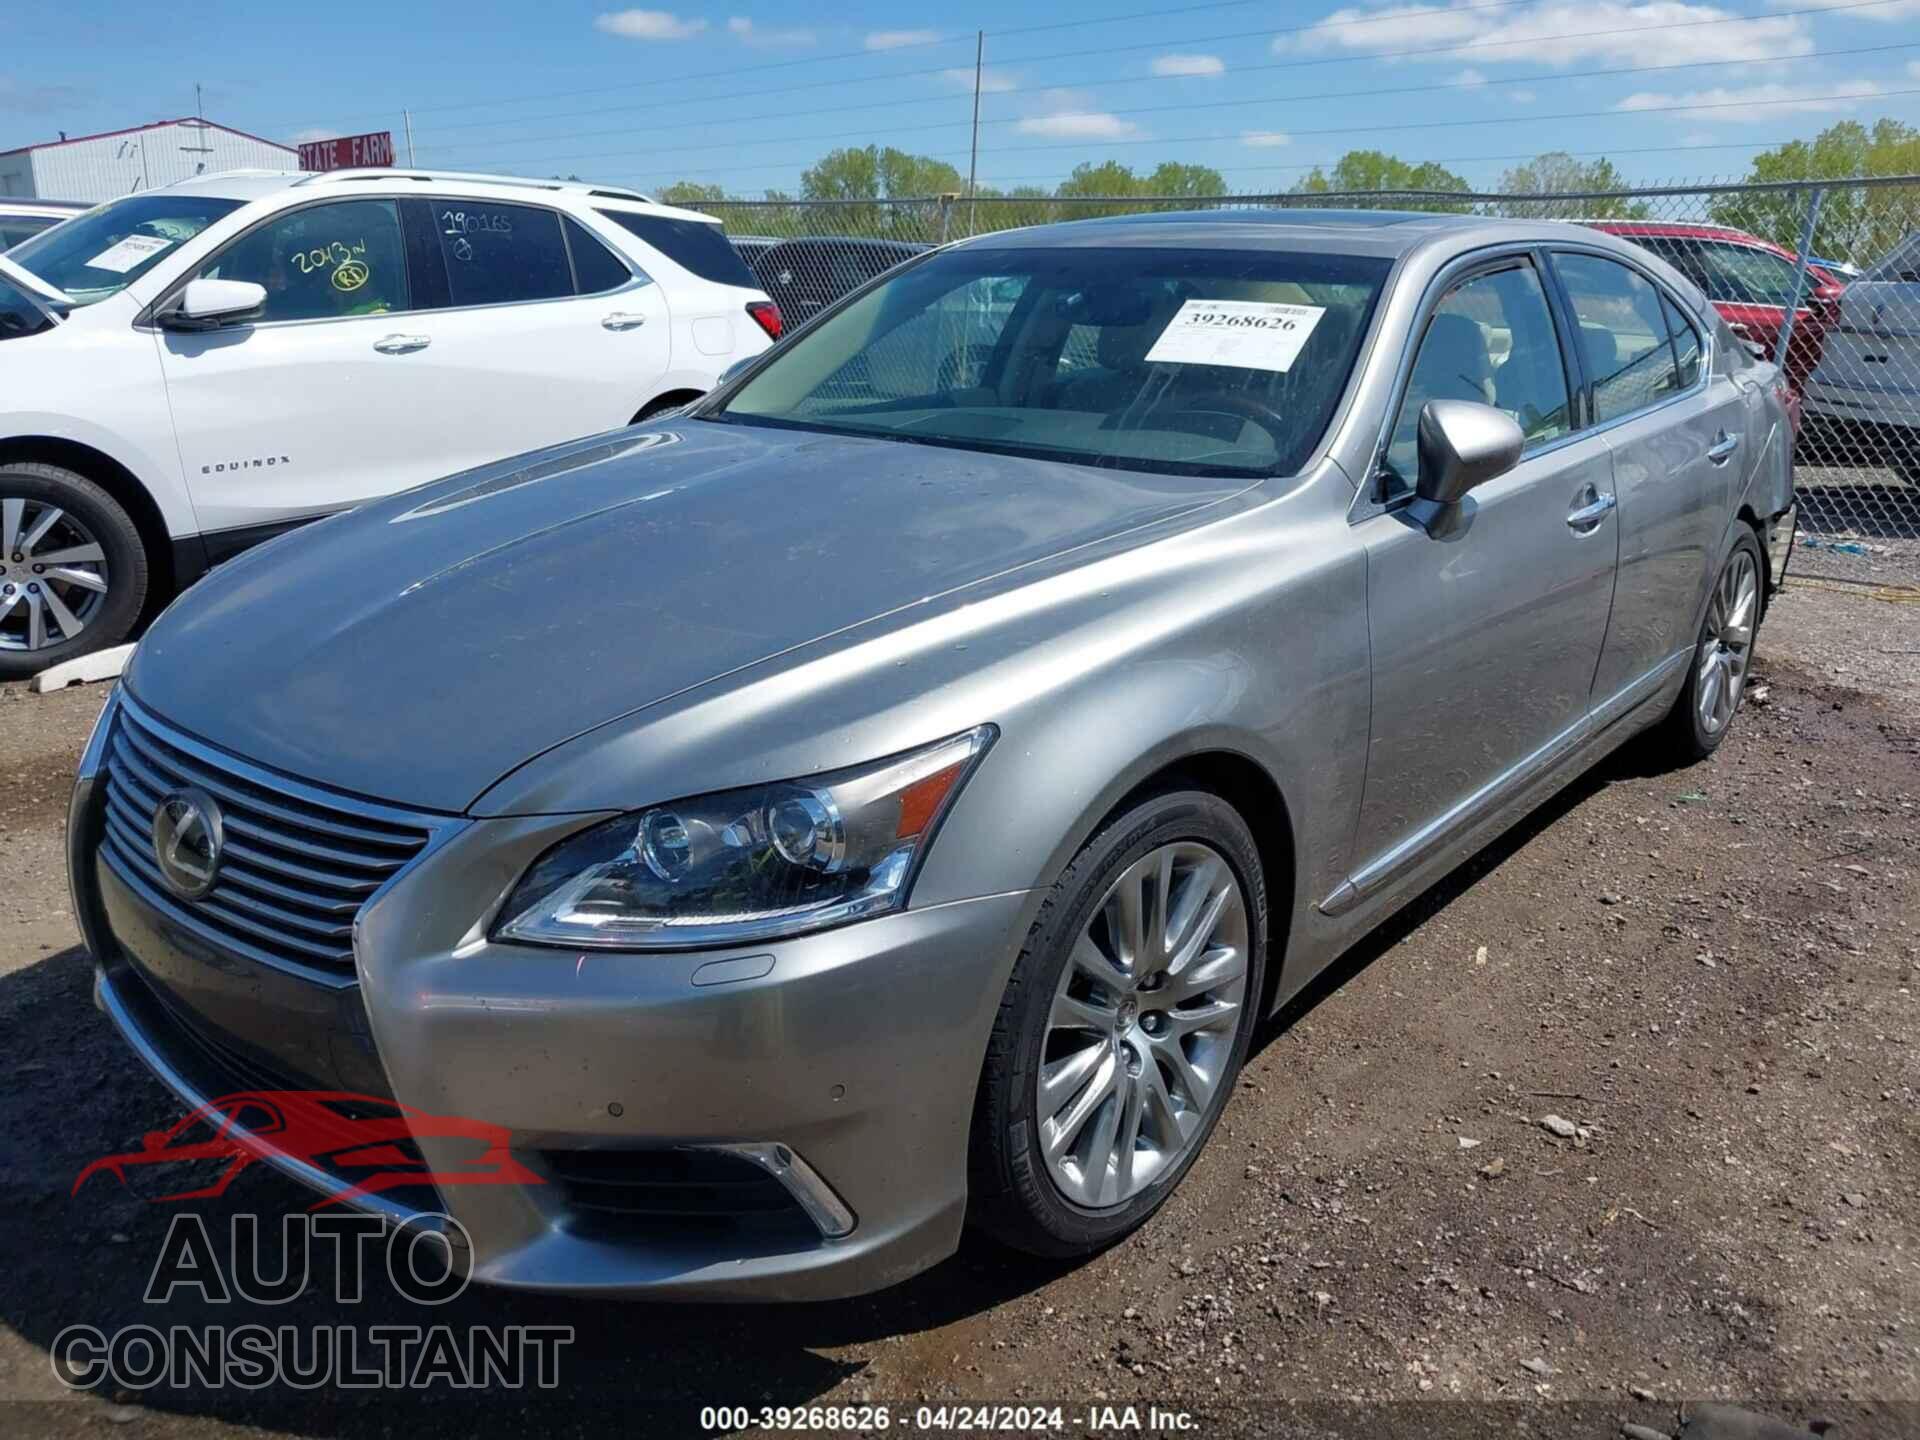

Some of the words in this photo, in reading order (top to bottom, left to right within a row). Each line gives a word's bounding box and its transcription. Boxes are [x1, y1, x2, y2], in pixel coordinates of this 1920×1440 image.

[299, 141, 339, 171] STATE
[352, 133, 391, 166] FARM
[1185, 313, 1297, 331] 39268626
[201, 456, 290, 474] EQUINOX
